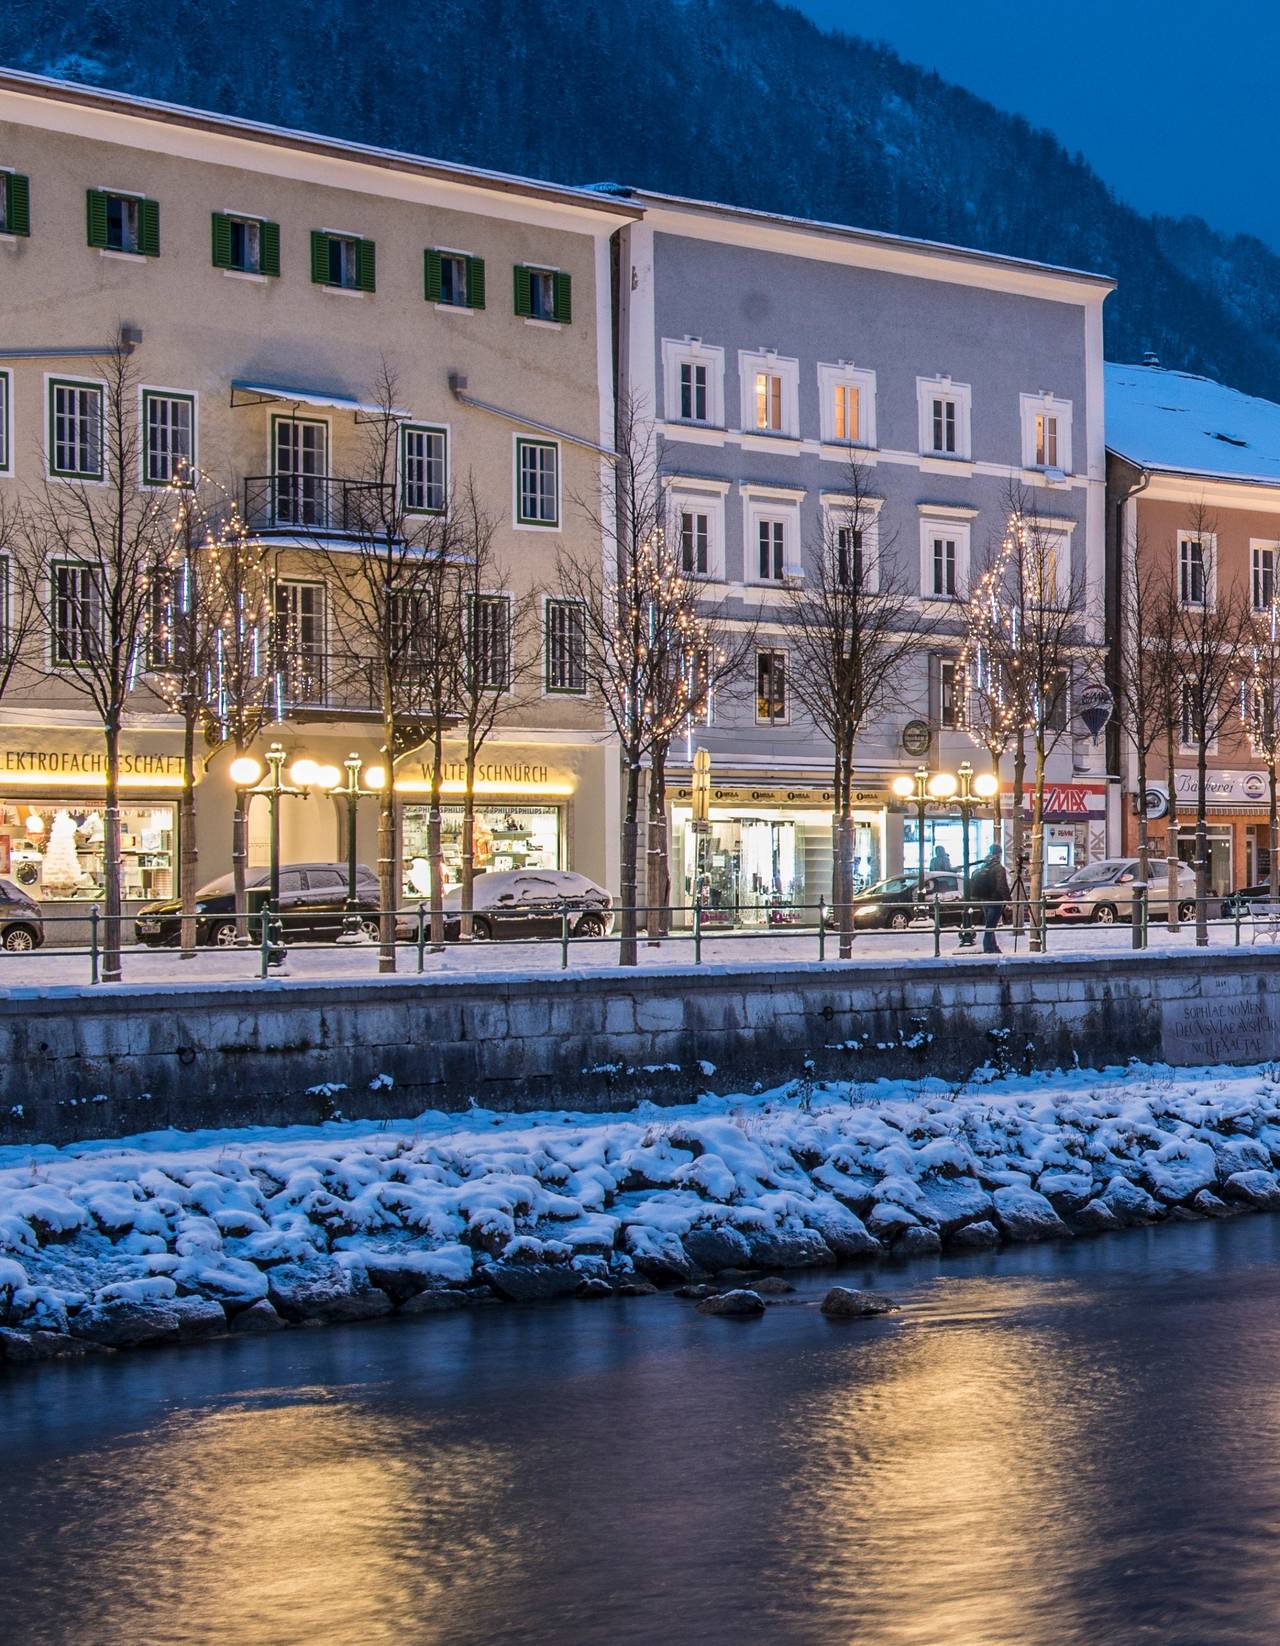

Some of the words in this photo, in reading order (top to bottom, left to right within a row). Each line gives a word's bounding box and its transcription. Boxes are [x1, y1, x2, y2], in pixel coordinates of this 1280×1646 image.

[421, 763, 468, 780] WLTE
[479, 762, 548, 783] SCHNÜRCH
[1176, 774, 1235, 793] Bäkerei
